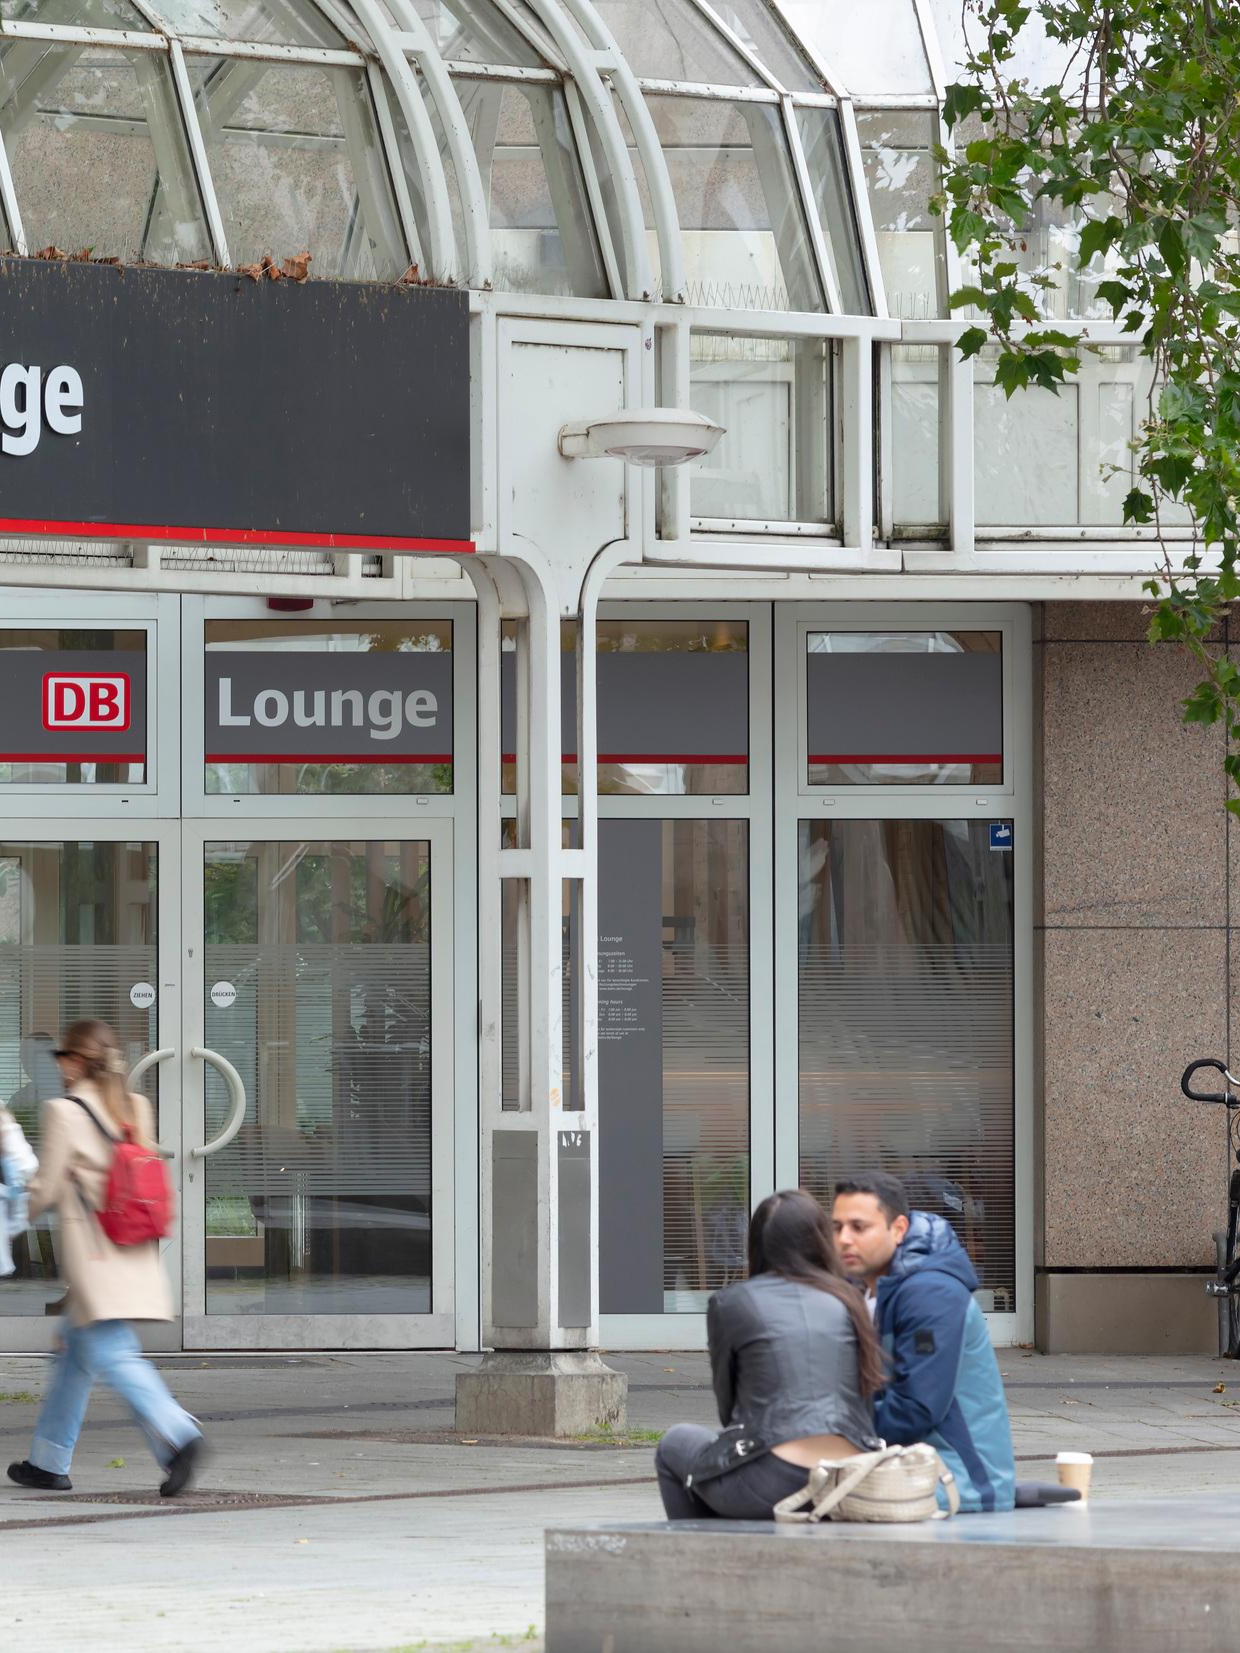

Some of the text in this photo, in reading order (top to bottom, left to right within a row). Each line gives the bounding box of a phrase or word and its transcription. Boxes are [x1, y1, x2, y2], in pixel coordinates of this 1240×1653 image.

[52, 677, 439, 740] DB Lounge
[600, 935, 623, 943] Lounge
